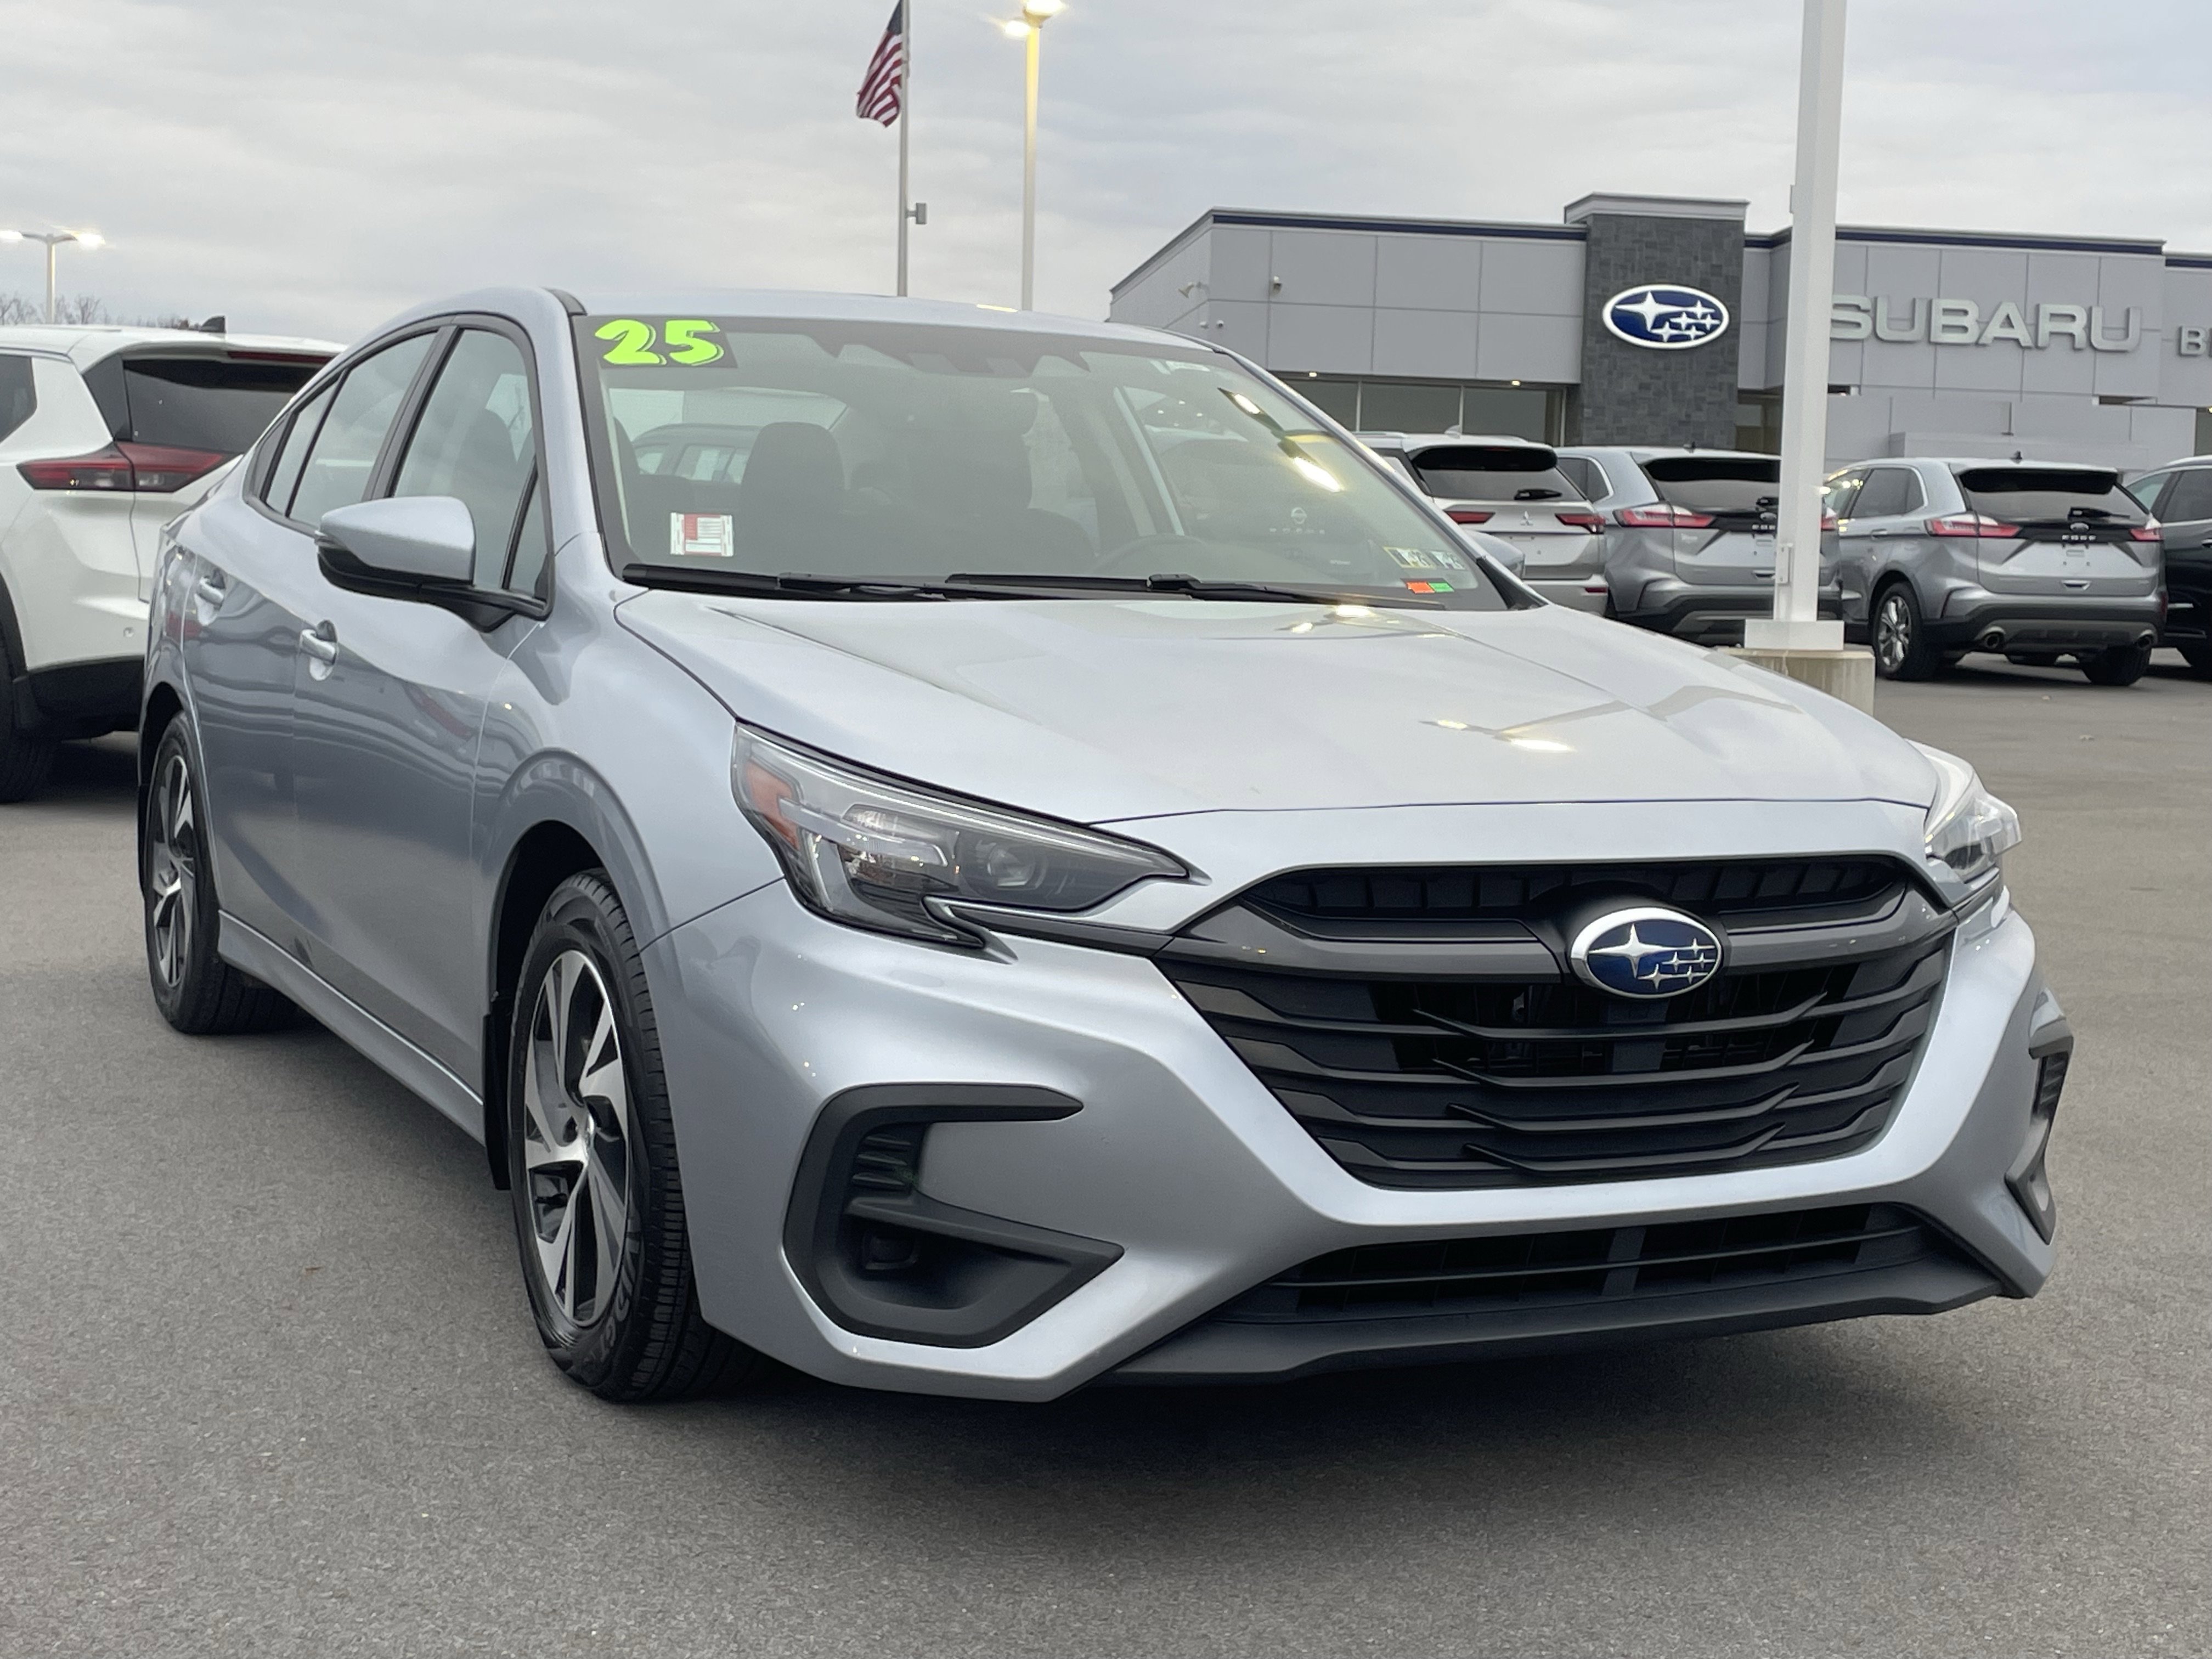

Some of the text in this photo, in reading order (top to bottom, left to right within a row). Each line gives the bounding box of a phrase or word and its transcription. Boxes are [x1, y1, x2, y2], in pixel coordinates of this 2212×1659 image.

[595, 319, 724, 365] 25
[1831, 295, 2212, 358] SUBARU B
